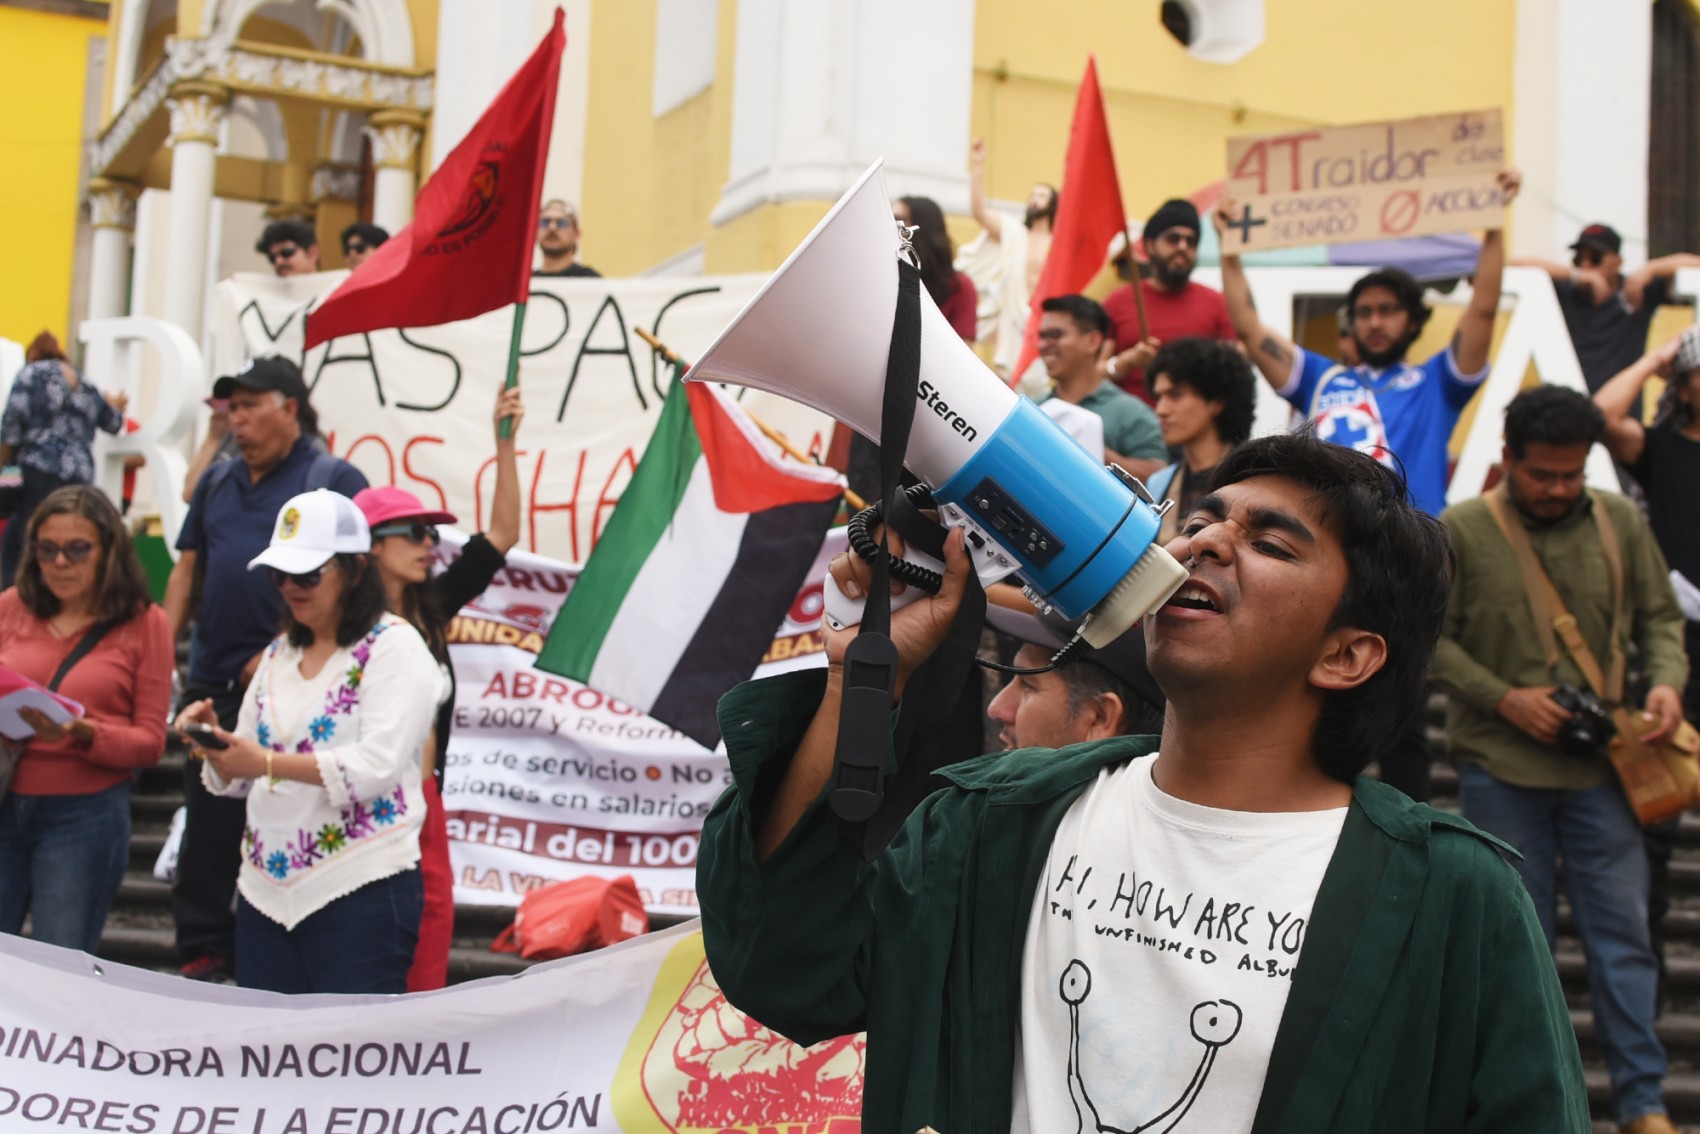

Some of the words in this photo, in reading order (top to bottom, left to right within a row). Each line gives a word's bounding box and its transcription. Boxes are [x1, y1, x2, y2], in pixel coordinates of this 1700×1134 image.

[917, 380, 977, 443] Steren
[478, 706, 543, 731] 2007
[483, 749, 518, 769] de
[525, 755, 638, 782] servicio
[671, 763, 714, 784] No
[551, 788, 589, 811] en
[546, 828, 615, 864] del
[462, 865, 502, 891] LA
[1110, 870, 1194, 928] HOW
[1194, 897, 1256, 946] ARE
[1095, 924, 1218, 965] UNFINISHED
[240, 1041, 483, 1078] NACIONAL
[173, 1106, 240, 1134] DE
[324, 1091, 603, 1134] EDUCACIÓN
